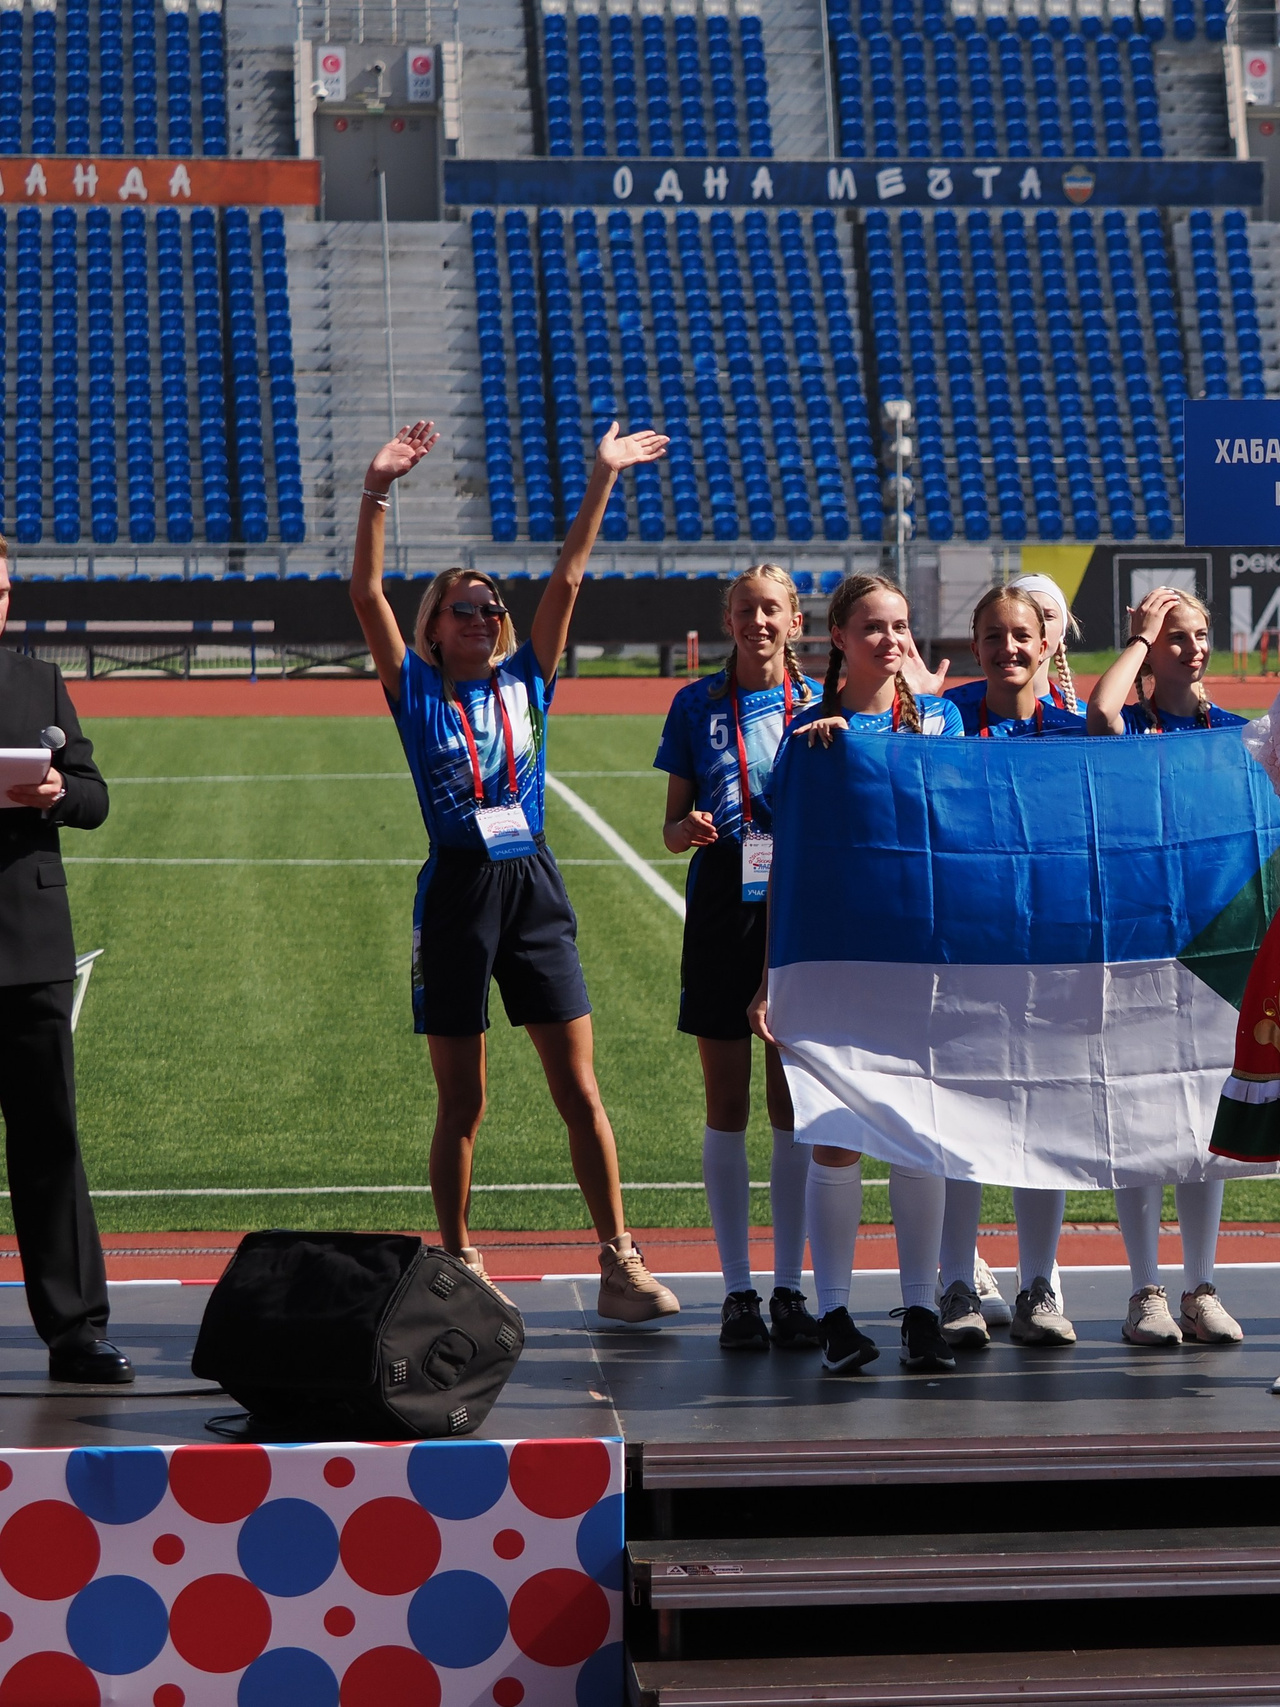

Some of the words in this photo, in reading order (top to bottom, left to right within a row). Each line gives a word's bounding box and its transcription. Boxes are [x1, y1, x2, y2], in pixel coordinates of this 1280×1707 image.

[0, 162, 192, 201] АНДА
[613, 165, 774, 203] ОДНА
[710, 713, 729, 750] 5
